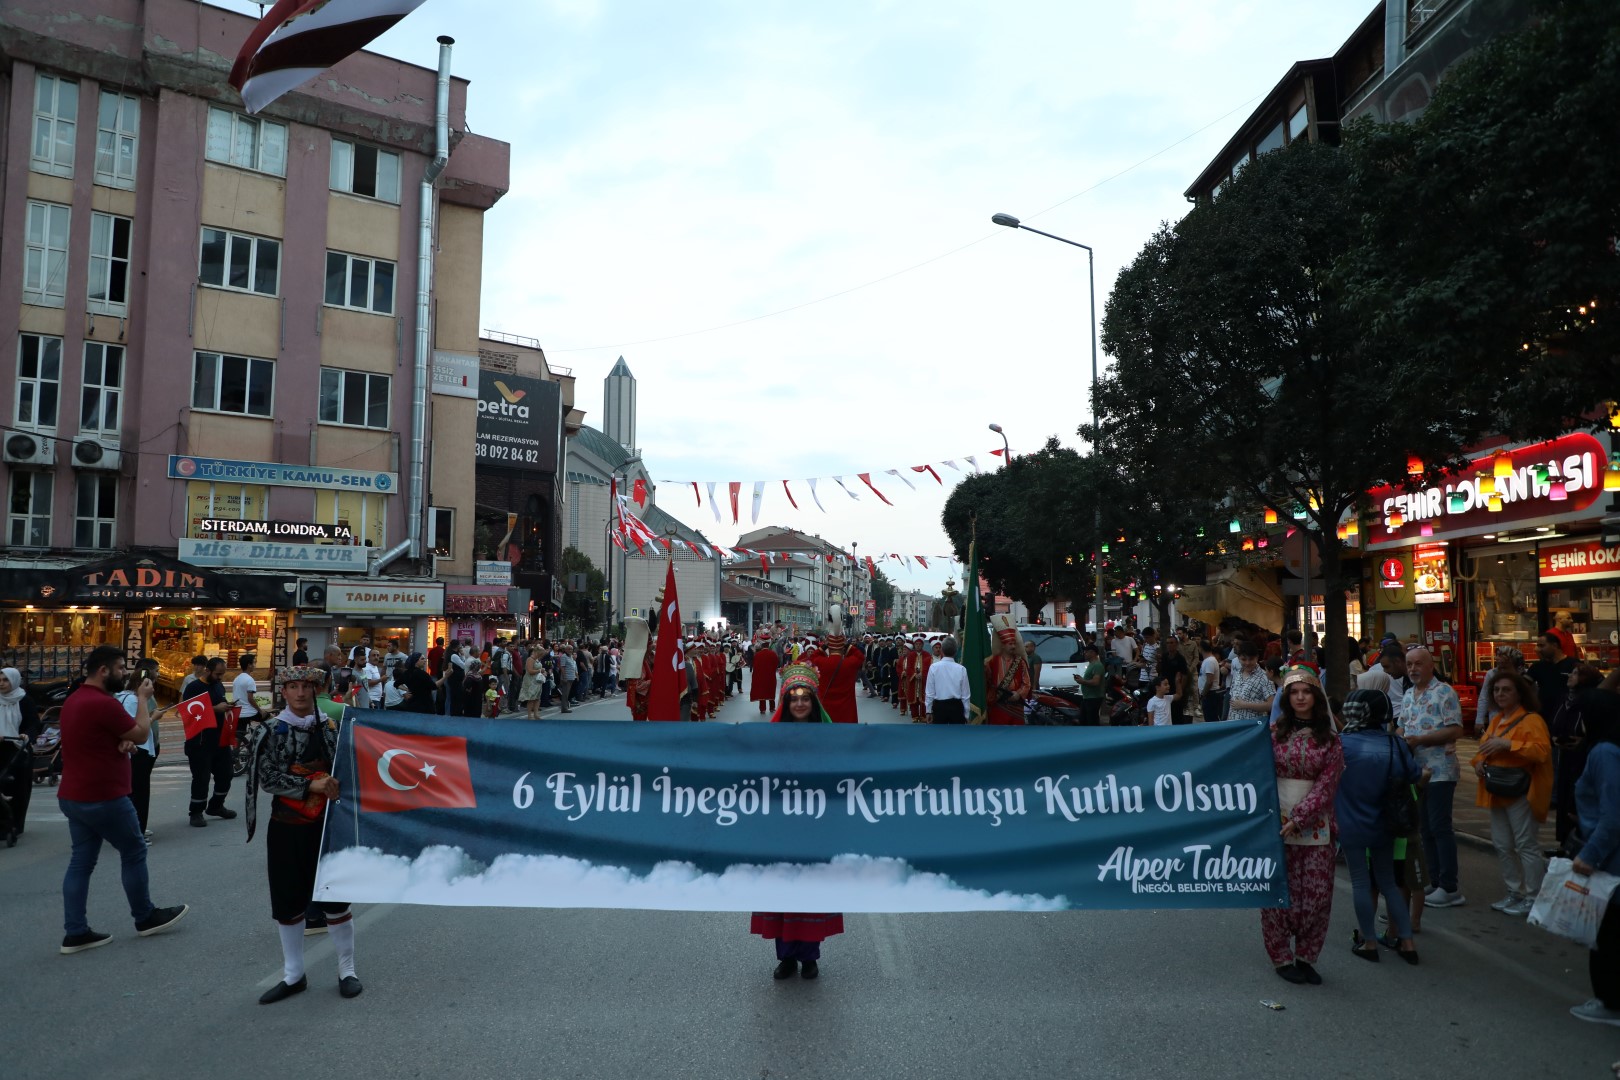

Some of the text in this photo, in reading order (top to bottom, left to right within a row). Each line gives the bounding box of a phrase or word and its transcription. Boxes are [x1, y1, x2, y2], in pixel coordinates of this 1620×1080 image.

[476, 397, 530, 418] petra
[491, 434, 540, 446] REZERVASYON
[489, 445, 509, 460] 092
[511, 447, 524, 462] 84
[525, 449, 539, 463] 82
[201, 461, 277, 480] TÜRKİYE
[282, 470, 372, 488] KAMU-SEN
[274, 523, 328, 539] LONDRA,
[334, 526, 351, 538] PA
[193, 541, 353, 562] MİS DİLLA TUR
[1550, 547, 1587, 572] ŞEHİR
[82, 567, 205, 589] TADIM
[345, 592, 426, 605] TADIM PİLİÇ
[512, 771, 536, 810] 6
[545, 772, 642, 821] Eylül
[836, 776, 1028, 827] Kurtuluşu
[1034, 774, 1145, 822] Kutlu
[1154, 771, 1258, 815] Olsun
[1097, 844, 1277, 894] Alper Taban
[1137, 881, 1271, 895] İNEGÖL BELEDİYE BAŞKANI
